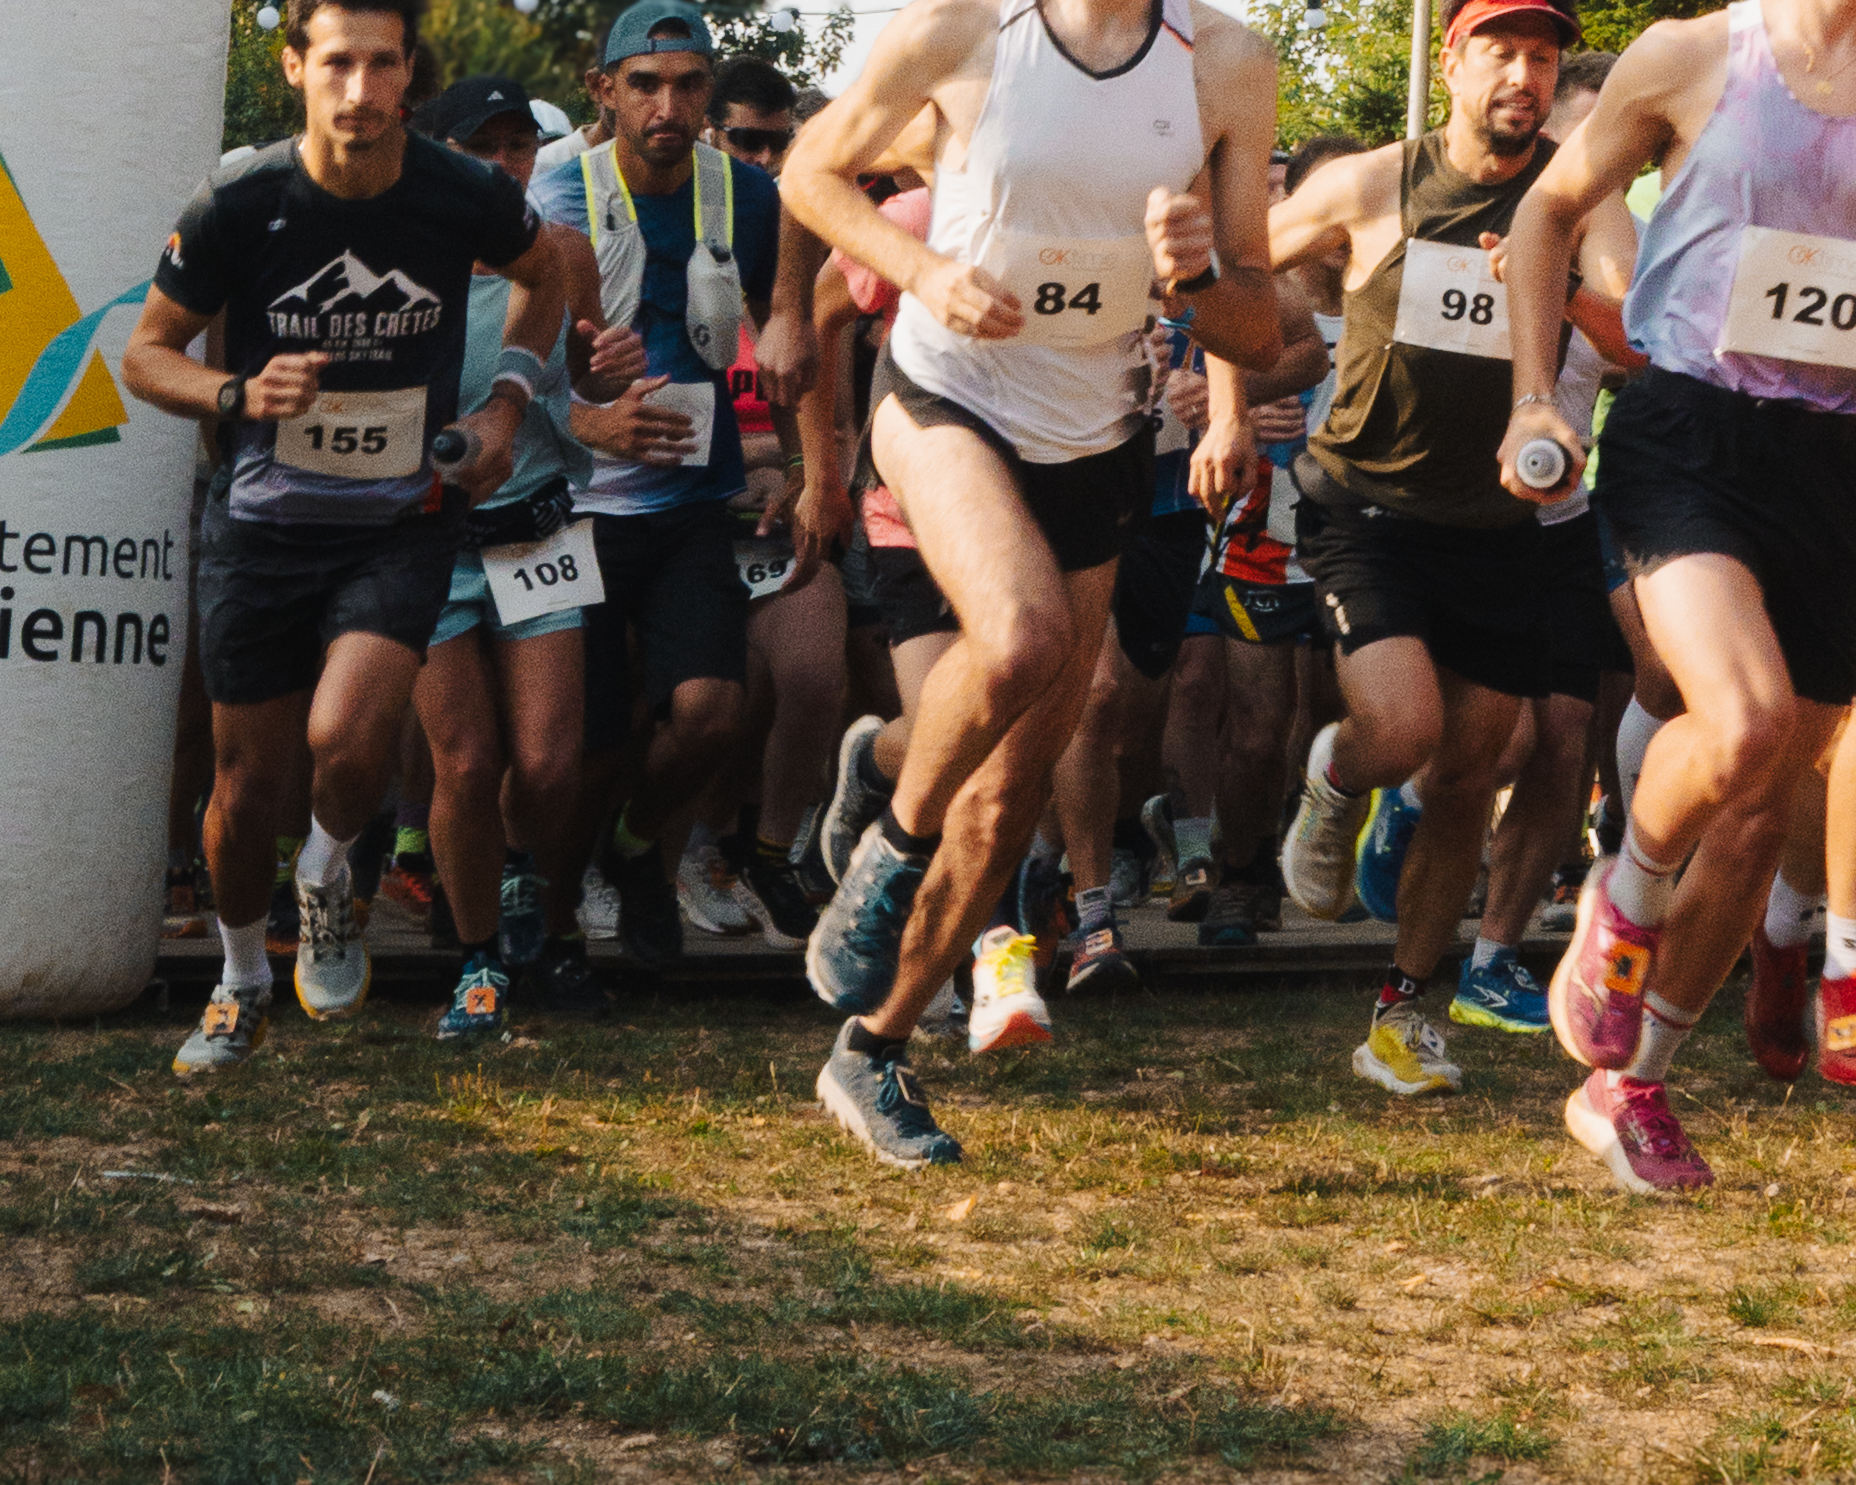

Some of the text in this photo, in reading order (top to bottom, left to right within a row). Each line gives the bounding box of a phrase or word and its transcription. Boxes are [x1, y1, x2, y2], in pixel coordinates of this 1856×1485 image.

[1033, 281, 1102, 316] 84
[1441, 287, 1495, 326] 98
[266, 312, 321, 339] TRAIL
[329, 312, 368, 337] DES
[303, 425, 388, 455] 155
[513, 553, 579, 591] 108
